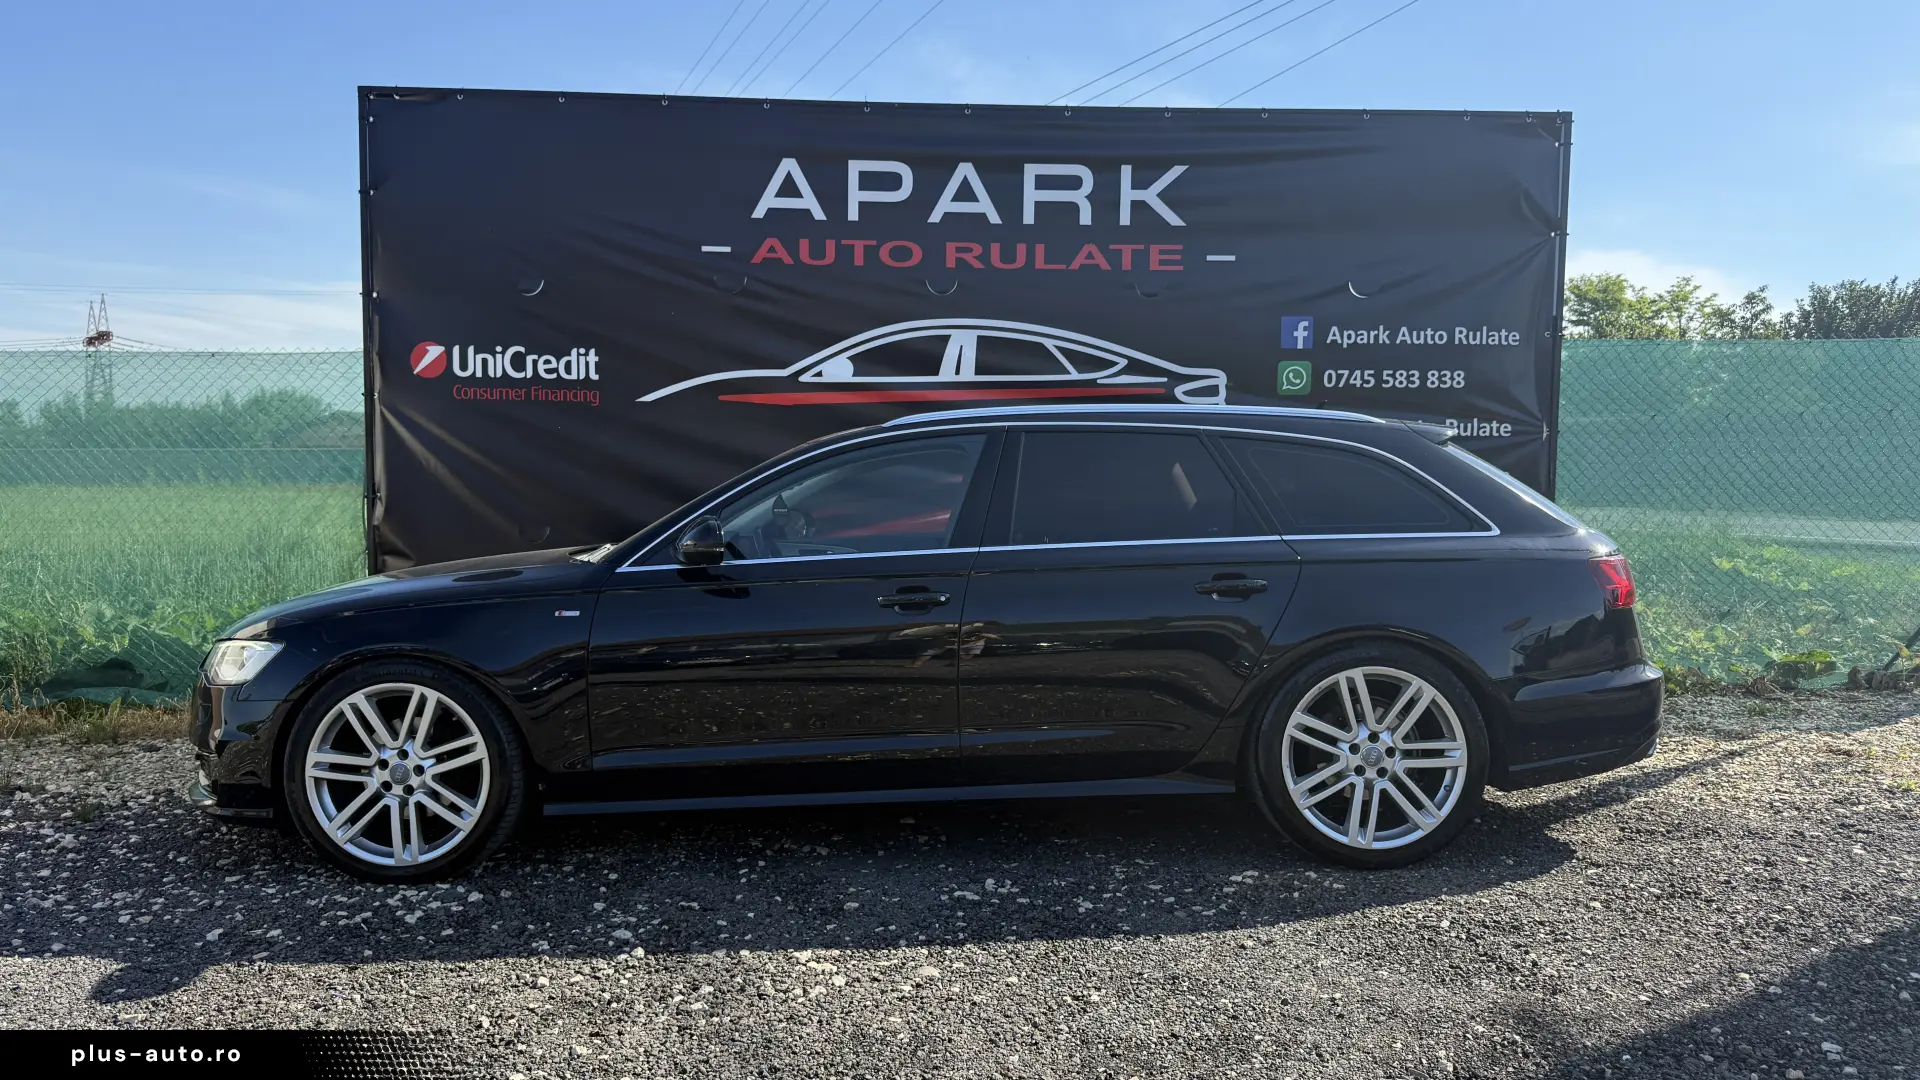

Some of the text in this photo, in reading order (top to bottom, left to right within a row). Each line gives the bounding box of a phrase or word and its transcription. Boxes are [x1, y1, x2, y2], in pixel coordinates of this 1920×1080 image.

[750, 157, 1190, 226] APARK
[749, 237, 1184, 271] AUTO RULATE
[1326, 325, 1520, 347] Apark Auto Rulate
[452, 344, 600, 380] UniCredit
[1323, 369, 1466, 389] 0745 583 838
[453, 384, 600, 406] Consumer Financing
